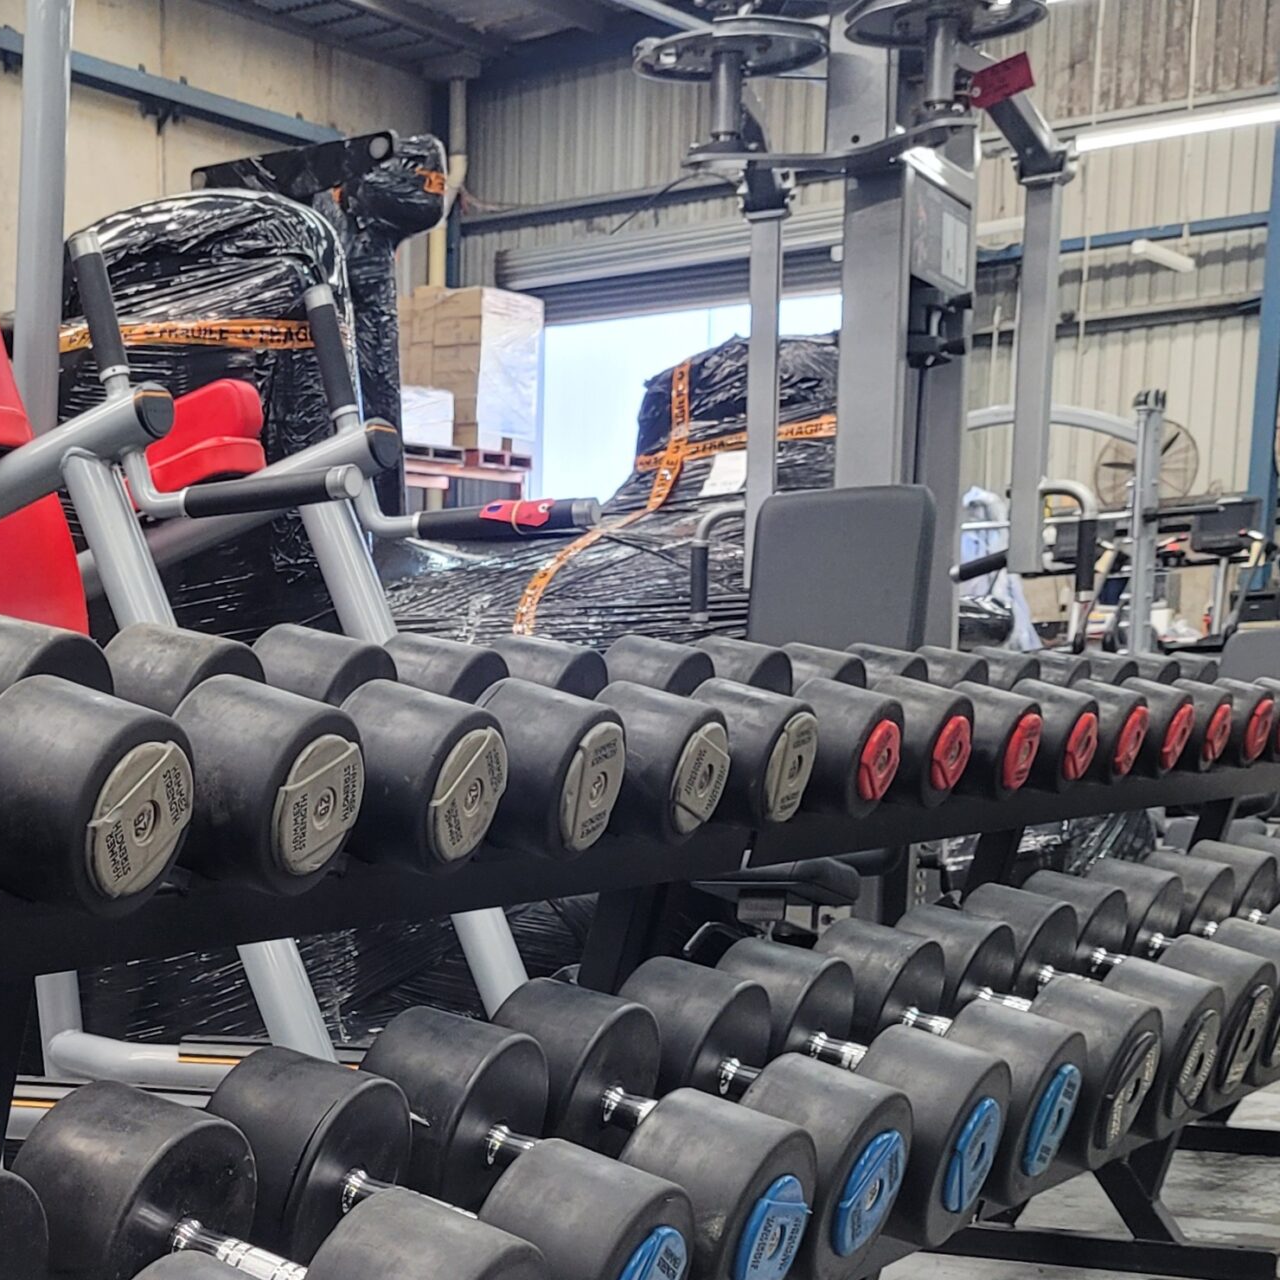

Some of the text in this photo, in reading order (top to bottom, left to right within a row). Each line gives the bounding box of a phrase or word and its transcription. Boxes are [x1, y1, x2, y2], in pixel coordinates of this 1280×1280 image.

[162, 770, 180, 825] STRENGTH
[112, 821, 131, 876] STRENGTH
[134, 812, 147, 837] 26
[106, 831, 122, 882] HAMMER
